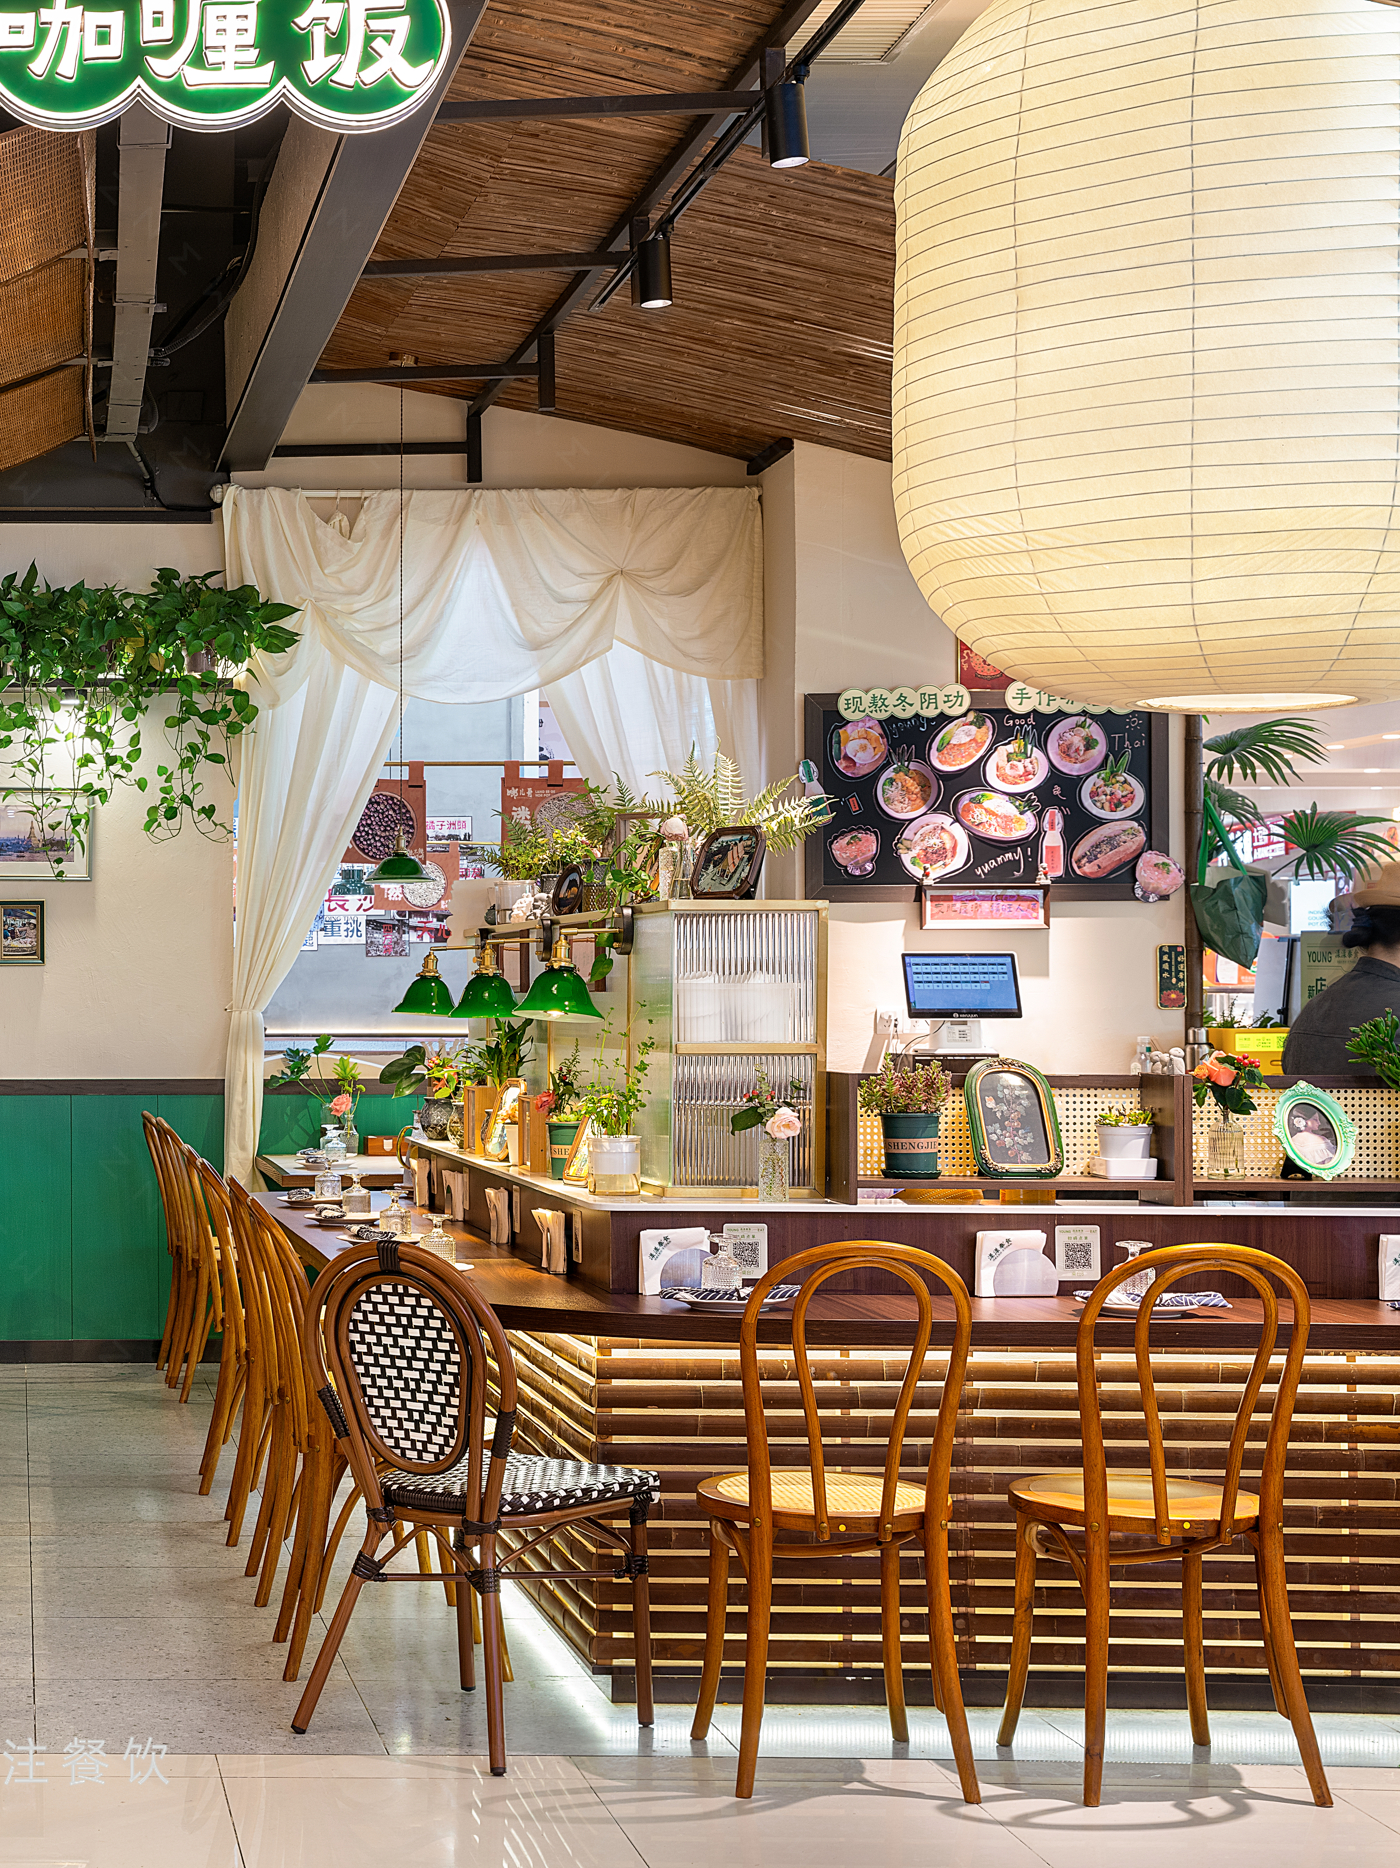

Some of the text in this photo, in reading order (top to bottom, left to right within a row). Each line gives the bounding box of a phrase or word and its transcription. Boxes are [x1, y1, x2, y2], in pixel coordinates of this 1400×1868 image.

[843, 690, 965, 714] 现熬冬阴功
[1012, 687, 1100, 707] 手作
[1003, 713, 1036, 727] Good
[1110, 733, 1146, 751] Thai
[1307, 950, 1333, 963] YOUNG
